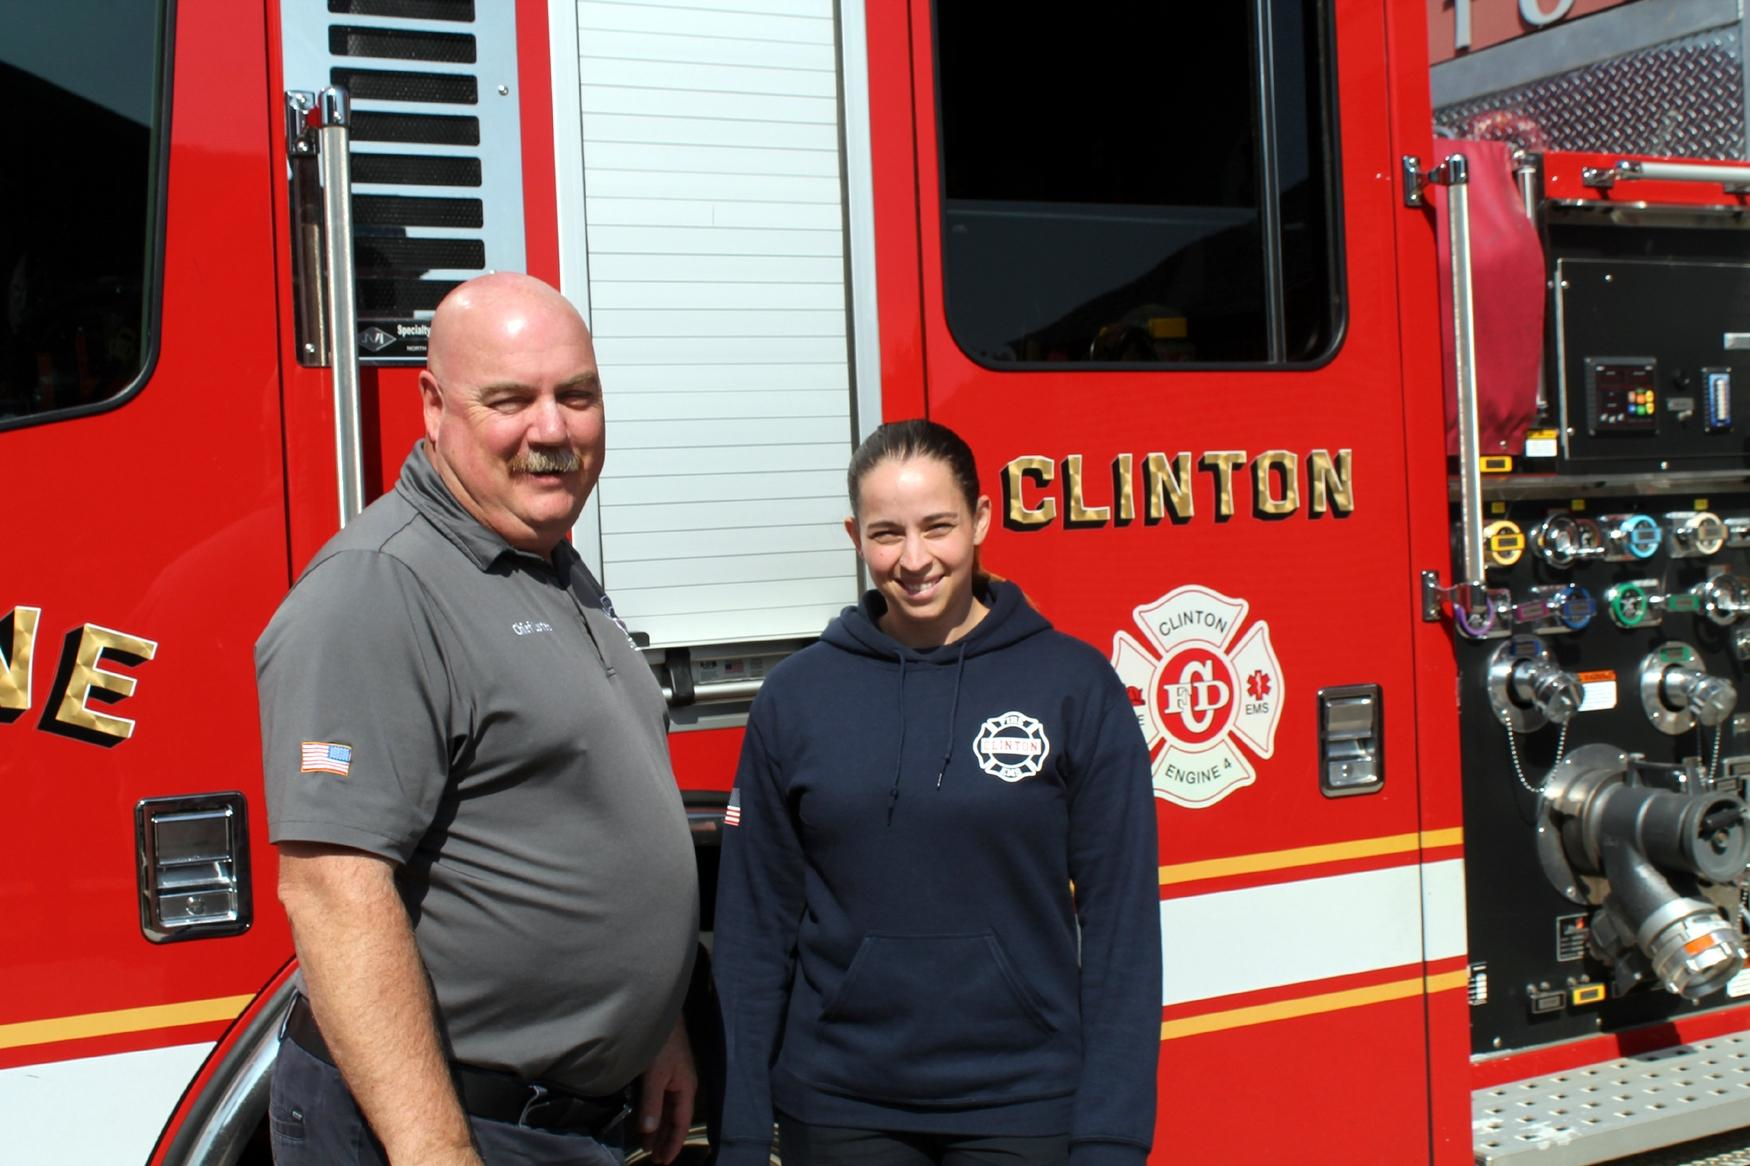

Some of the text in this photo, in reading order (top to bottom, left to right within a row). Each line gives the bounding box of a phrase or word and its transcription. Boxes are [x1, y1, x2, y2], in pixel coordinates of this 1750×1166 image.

[397, 325, 431, 338] Specialty
[1000, 449, 1355, 532] CLINTON
[1158, 610, 1228, 637] CLINTON
[1245, 702, 1269, 716] EMS
[983, 740, 1038, 753] CLINTON
[1164, 757, 1232, 785] ENGINE 4
